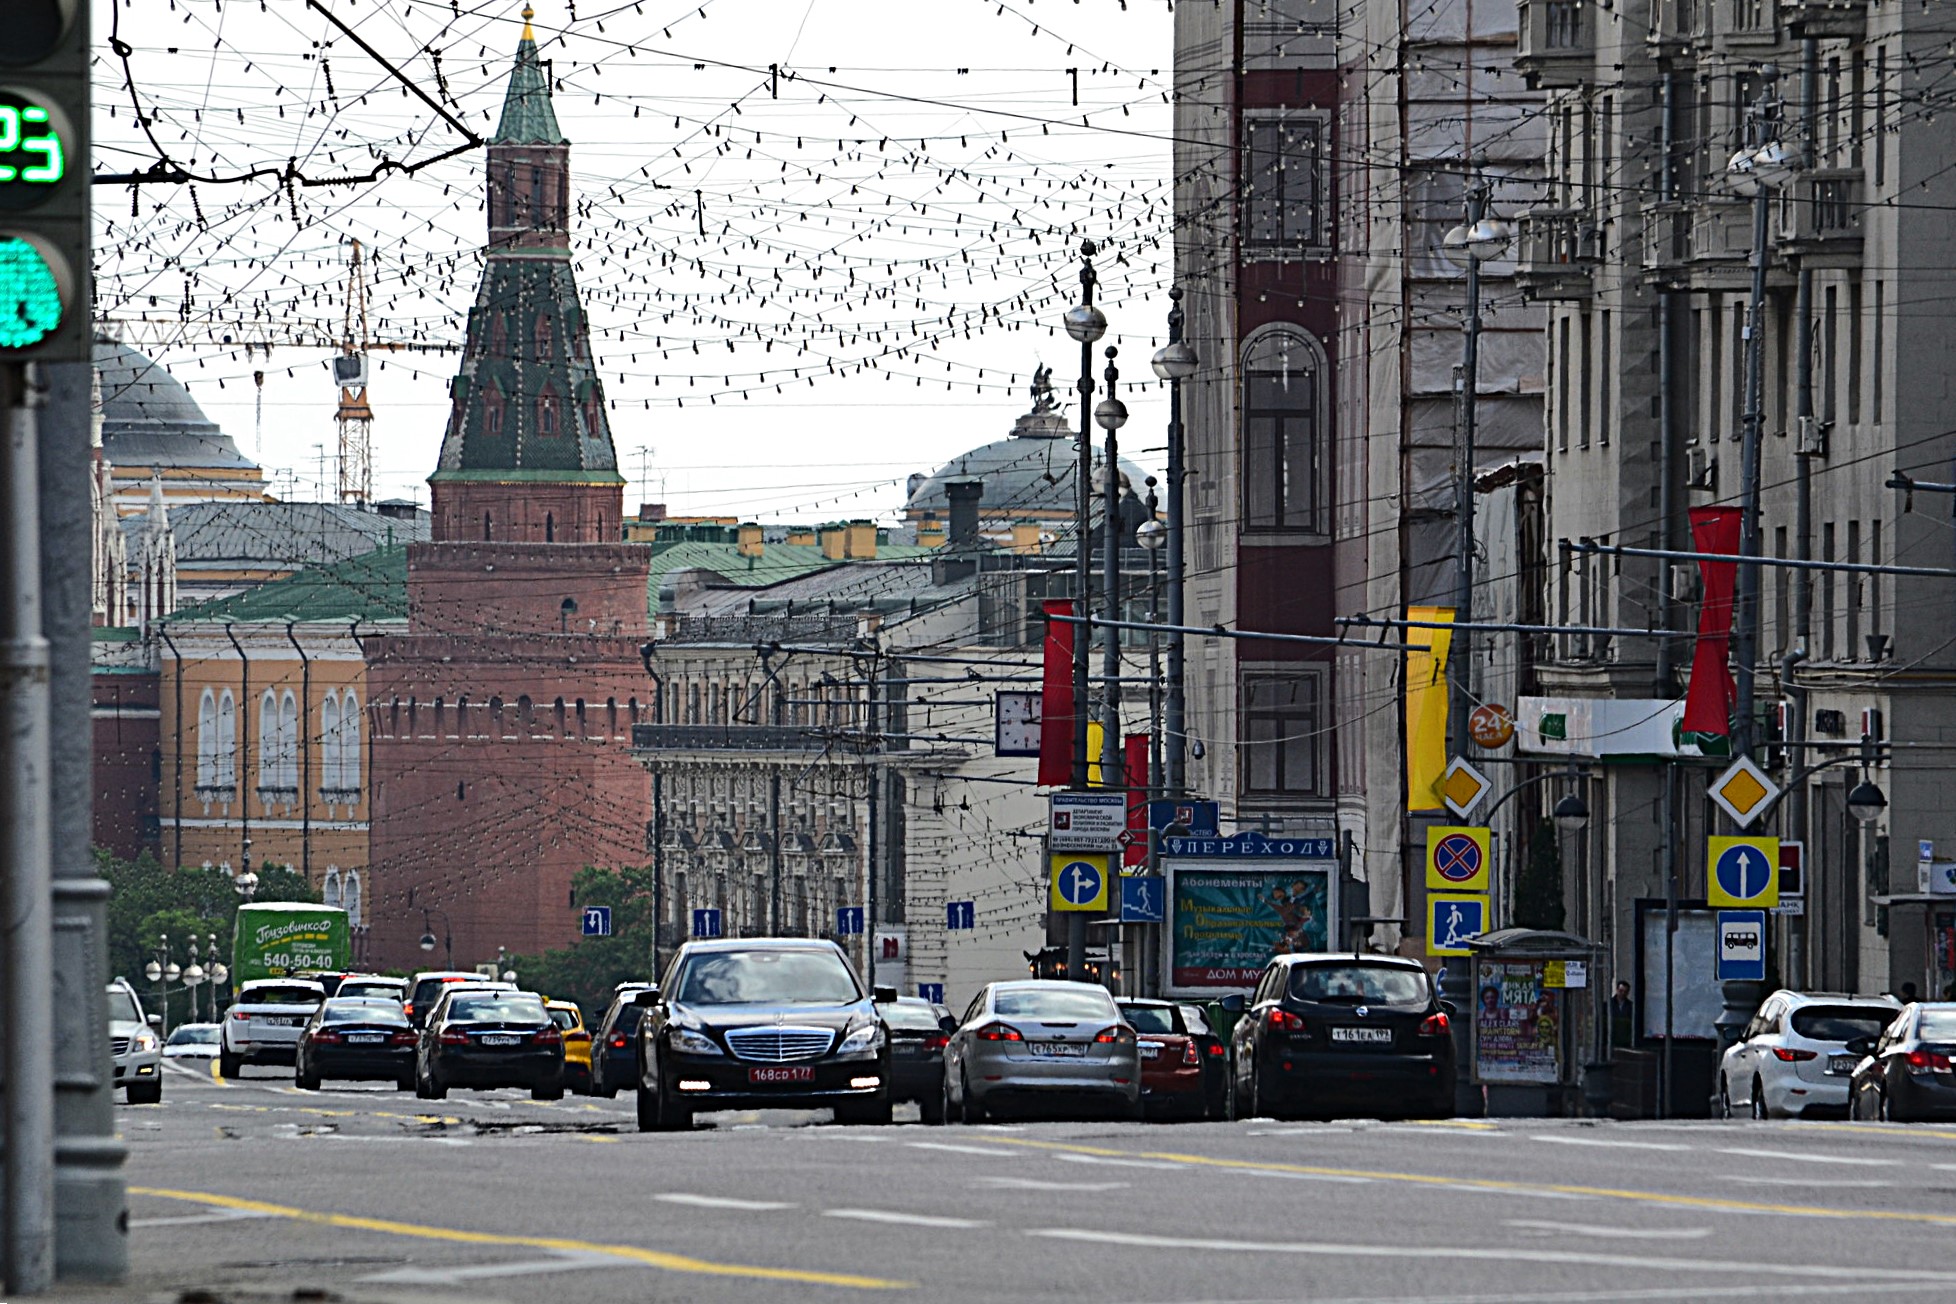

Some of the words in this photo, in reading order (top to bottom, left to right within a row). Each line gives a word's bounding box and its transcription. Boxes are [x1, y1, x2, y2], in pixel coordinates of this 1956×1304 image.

[1474, 714, 1501, 732] 24
[1187, 842, 1313, 854] ПЕРЕХОД
[1181, 877, 1263, 888] Абонементы
[263, 953, 333, 968] 540-50-40
[1502, 990, 1538, 1004] МЯТА
